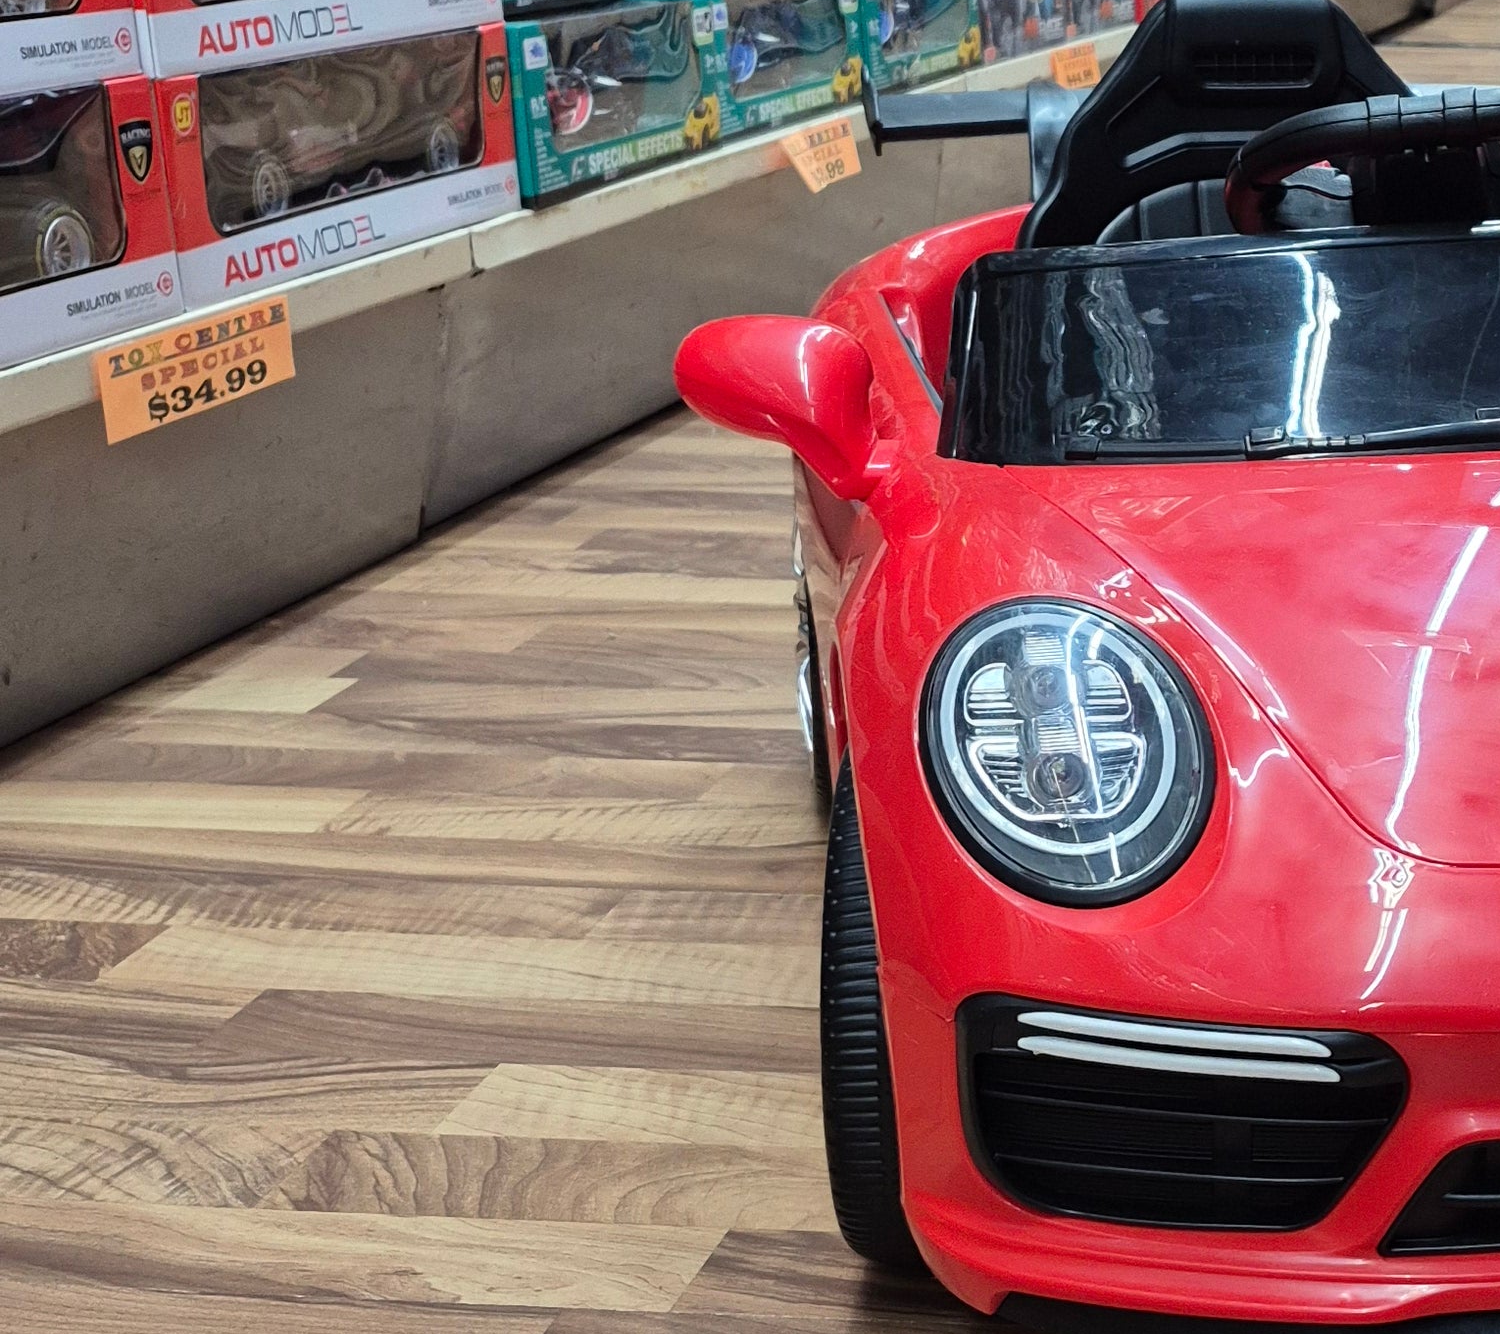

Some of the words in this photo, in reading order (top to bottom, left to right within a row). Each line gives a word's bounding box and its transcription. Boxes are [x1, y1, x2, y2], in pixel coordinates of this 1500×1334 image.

[20, 39, 78, 60] SIMULATION
[81, 35, 115, 52] MODEL
[759, 94, 798, 119] SPECIAL
[120, 127, 152, 144] RACING
[588, 144, 636, 175] SPECIAL
[637, 130, 684, 160] EFFECTS
[66, 291, 122, 318] SIMULATION
[124, 282, 158, 301] MODEL
[108, 339, 165, 376] TOY
[173, 303, 286, 357] CENTRE
[140, 335, 266, 393] SPECIAL
[148, 359, 268, 424] $34.99
